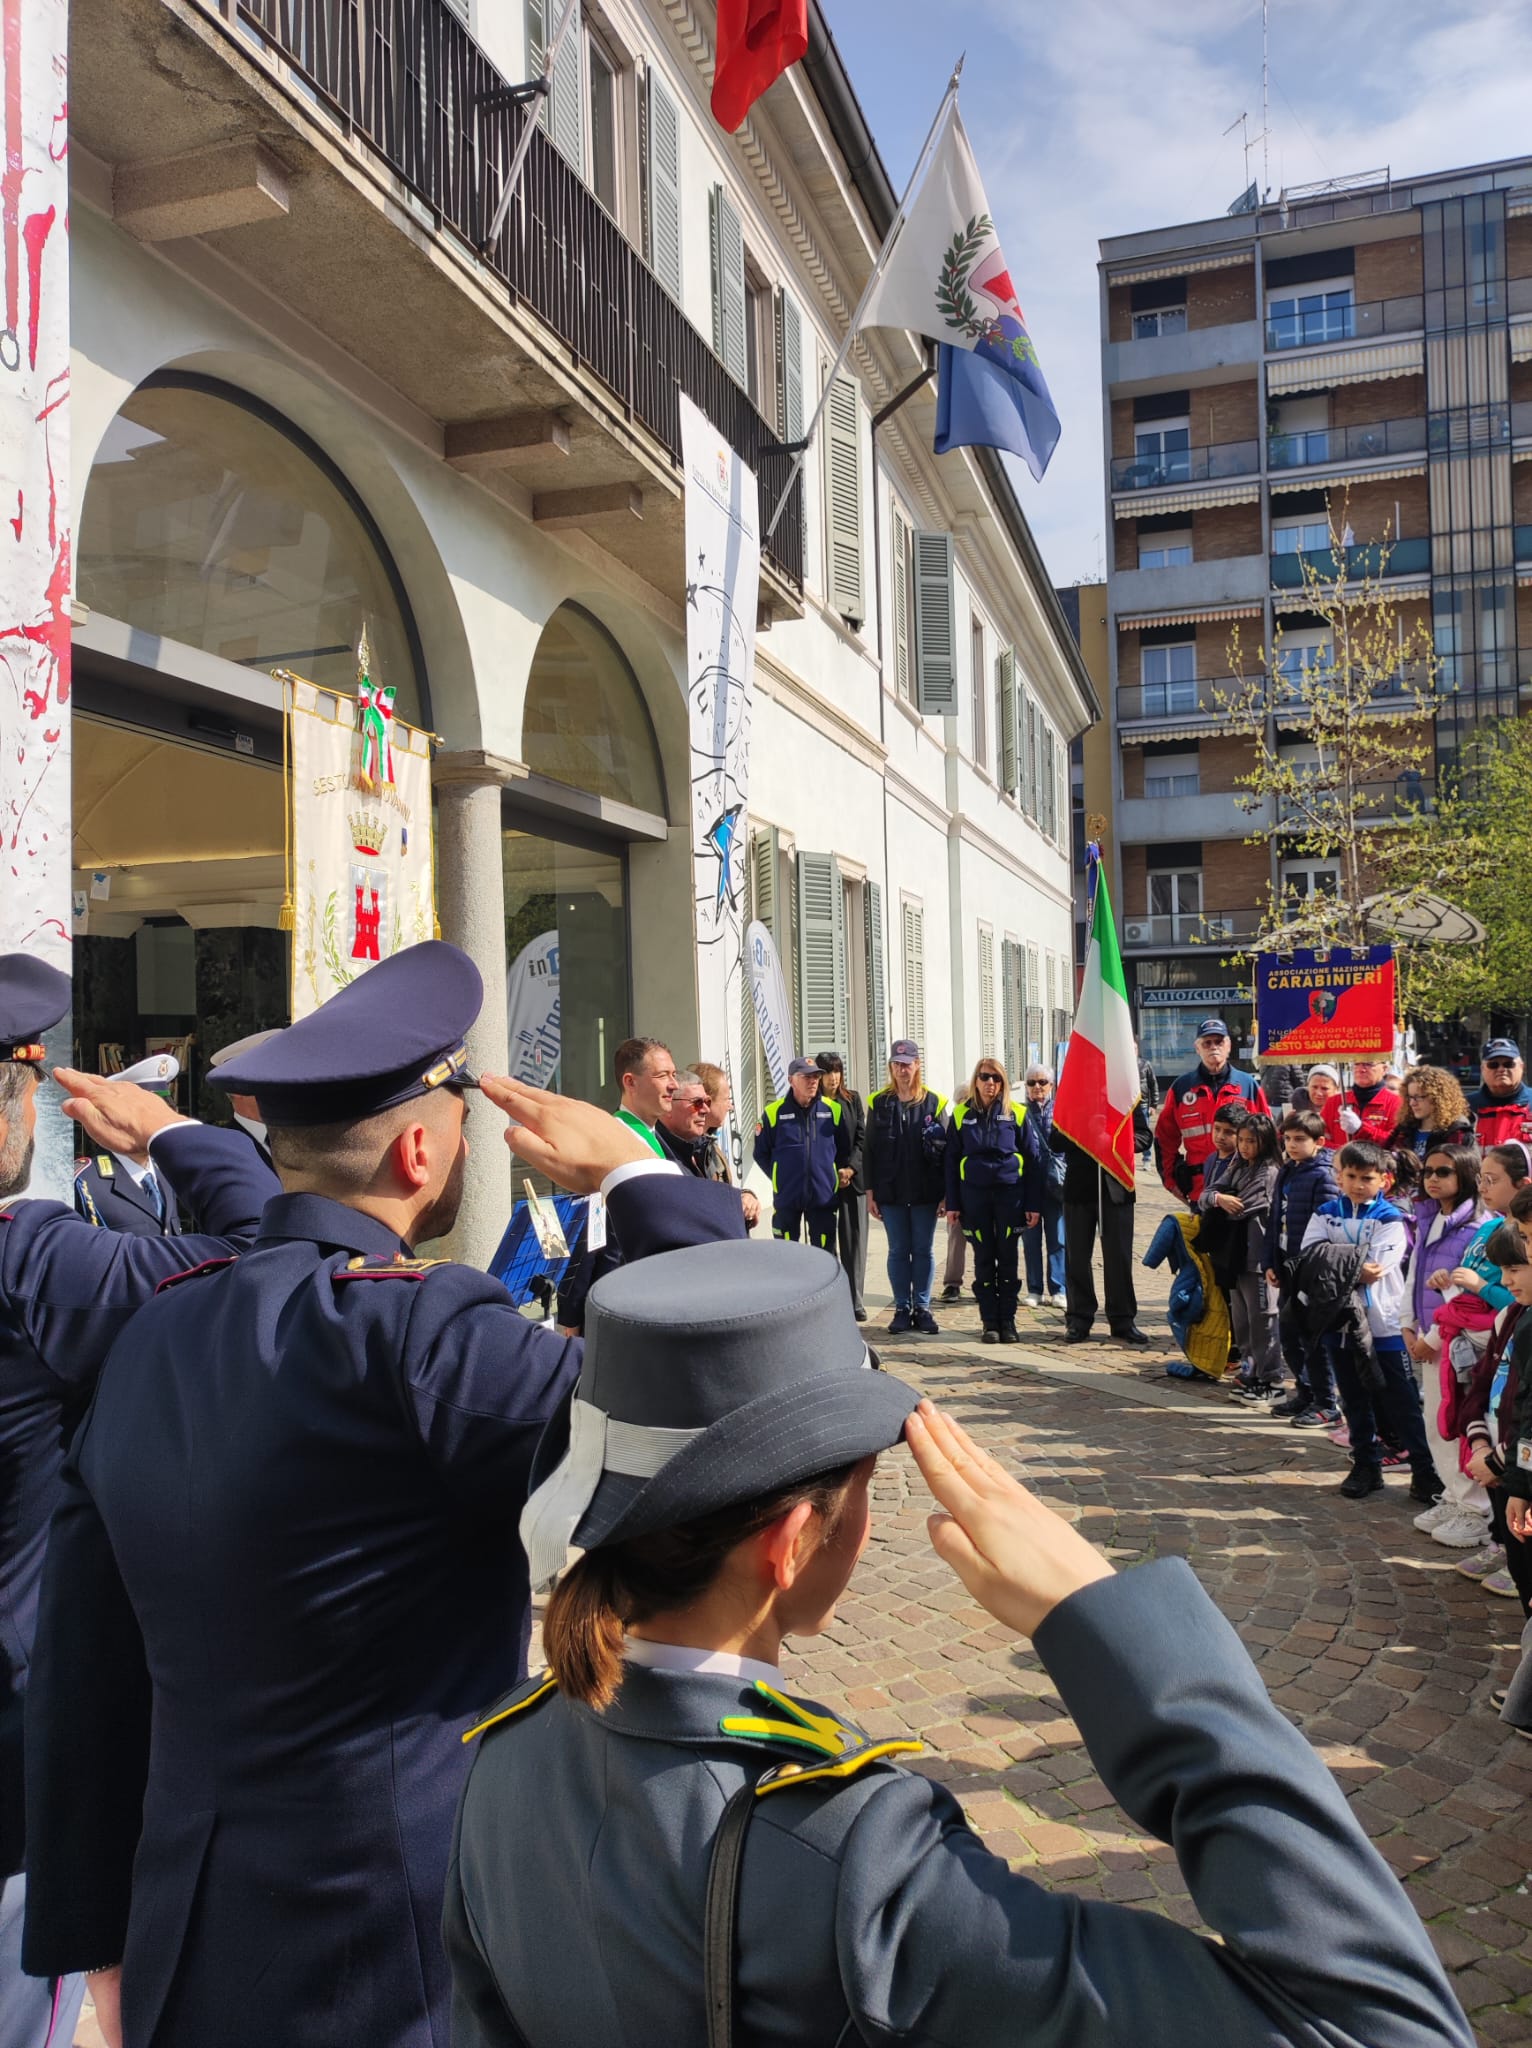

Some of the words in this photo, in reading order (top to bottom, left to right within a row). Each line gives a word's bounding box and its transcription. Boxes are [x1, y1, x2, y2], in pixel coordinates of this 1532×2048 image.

[1268, 967, 1329, 977] ASSOCIAZIONE
[1332, 965, 1382, 973] NAZIONALE
[1267, 971, 1382, 990] CARABINIERI
[1147, 989, 1242, 1002] AUTOSCUOLA
[1268, 1028, 1306, 1036] Nucleo
[1310, 1025, 1382, 1034] Volontariato
[1346, 1031, 1381, 1039] Civile
[1268, 1041, 1302, 1051] SESTO
[1305, 1040, 1325, 1049] SAN
[1327, 1039, 1382, 1049] GIOVANNI
